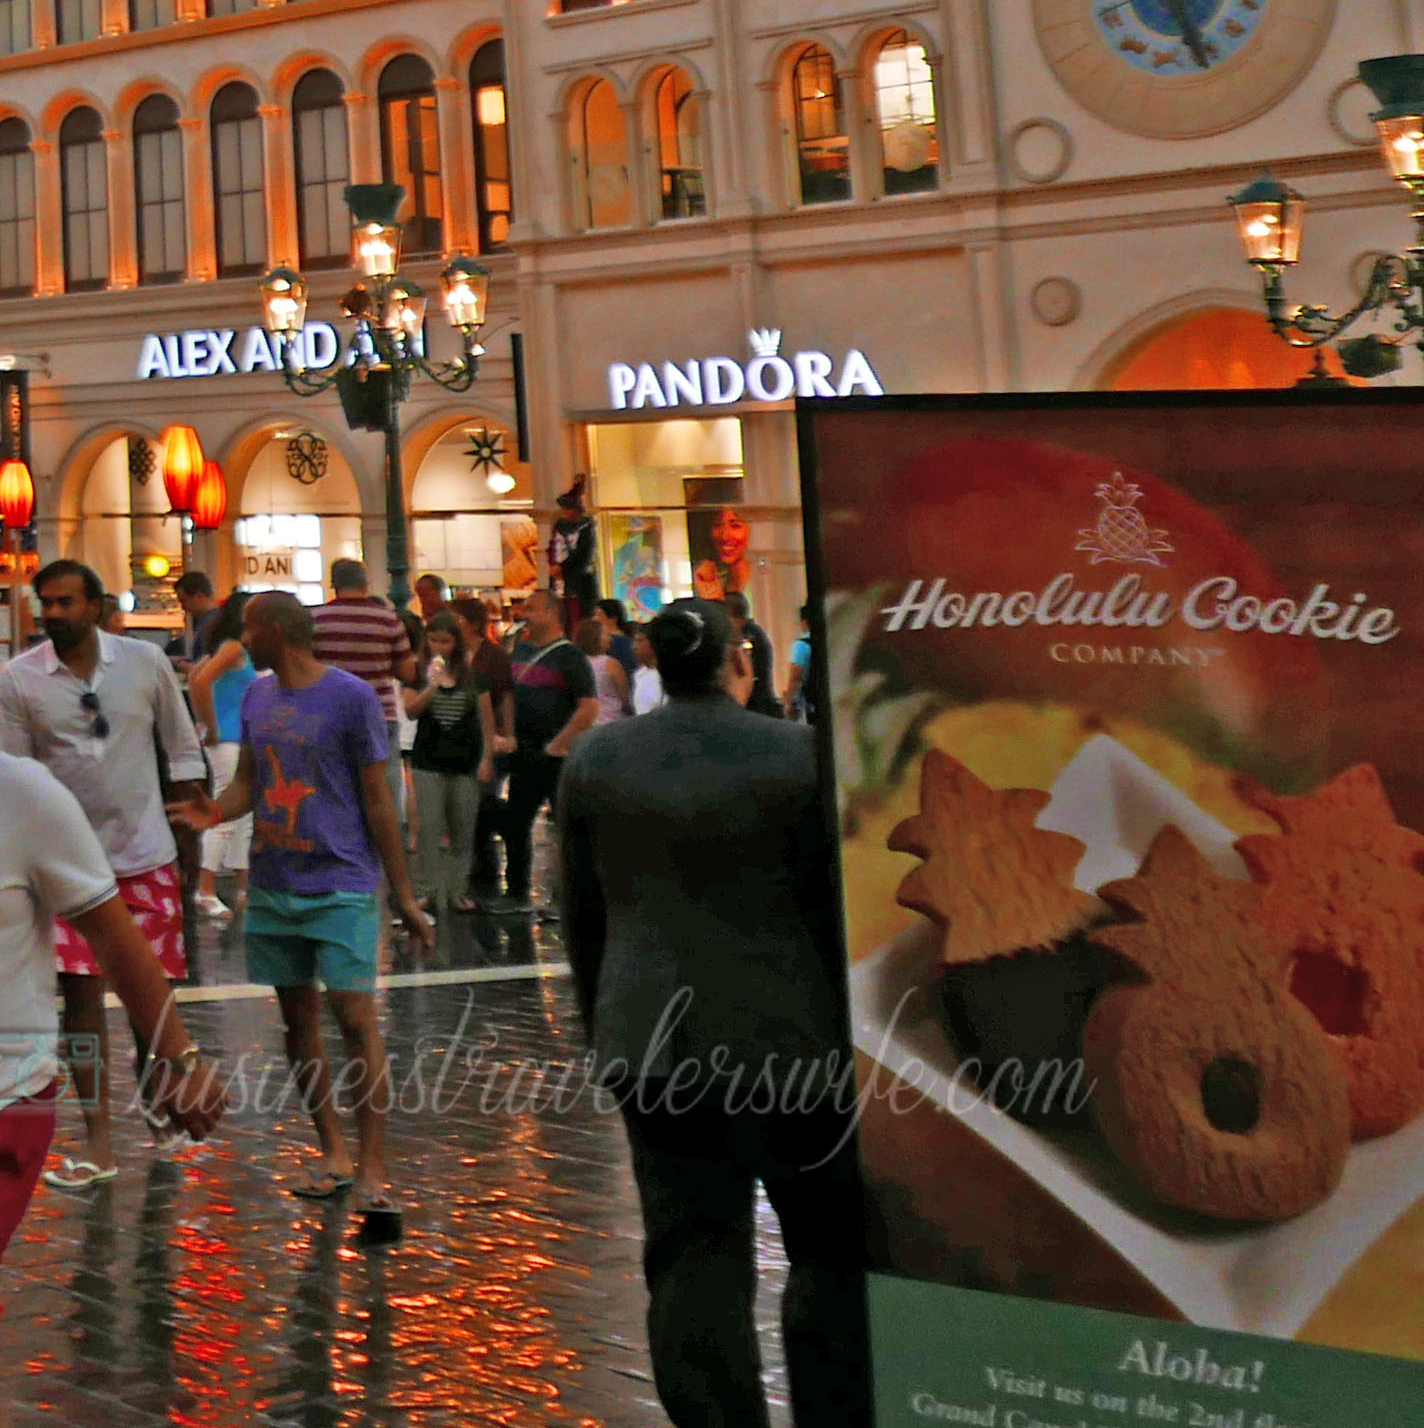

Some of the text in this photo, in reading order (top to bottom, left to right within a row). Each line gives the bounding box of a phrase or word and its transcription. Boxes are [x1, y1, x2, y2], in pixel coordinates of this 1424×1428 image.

[136, 329, 238, 380] ALEX
[608, 349, 885, 410] PANDORA
[881, 573, 1402, 645] Honolulu Cookie
[1049, 642, 1212, 670] COMPANY
[1116, 1338, 1265, 1393] Aloha!
[984, 1365, 1047, 1398] Visit
[1053, 1384, 1086, 1406] us
[1136, 1394, 1179, 1423] the
